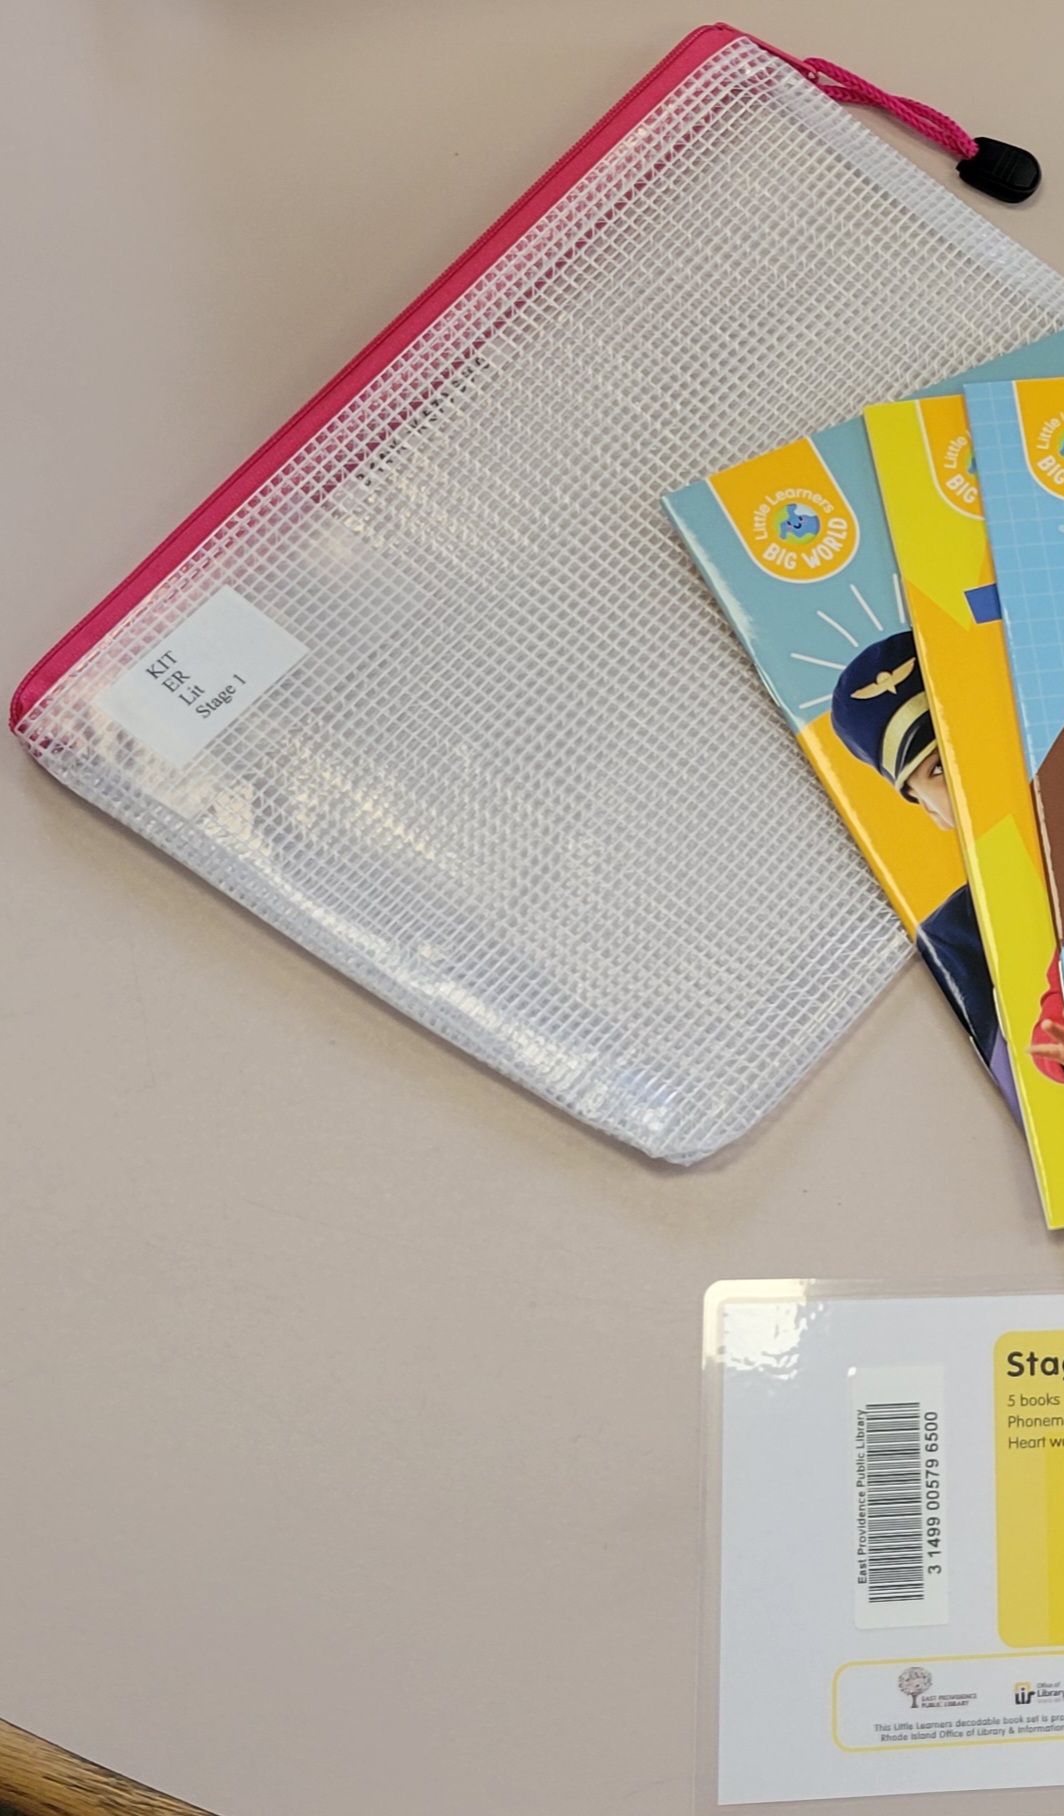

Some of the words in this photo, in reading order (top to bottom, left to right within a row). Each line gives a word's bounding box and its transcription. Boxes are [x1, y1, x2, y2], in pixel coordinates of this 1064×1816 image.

[1036, 417, 1060, 450] Little
[944, 435, 967, 469] Little
[945, 474, 979, 504] BIG
[753, 503, 771, 540] Little
[765, 488, 834, 514] Learners
[762, 542, 798, 570] BIG
[801, 517, 848, 569] WORLD
[145, 650, 178, 680] KIT
[161, 670, 191, 693] ER
[178, 683, 205, 706] Lit
[195, 683, 236, 719] Stage
[232, 673, 247, 685] 1
[1007, 1394, 1015, 1407] 5
[1020, 1393, 1061, 1407] books
[855, 1409, 867, 1449] Library
[924, 1411, 939, 1453] 6500
[1008, 1436, 1046, 1449] Heart
[856, 1453, 866, 1488] Public
[926, 1459, 940, 1511] 00579
[857, 1490, 867, 1555] Providence
[927, 1517, 942, 1558] 1499
[857, 1558, 867, 1584] East
[927, 1564, 942, 1574] 3
[874, 1723, 891, 1732] This
[893, 1722, 913, 1731] Little
[916, 1720, 952, 1730] Learners
[955, 1717, 1000, 1728] decodable
[1002, 1715, 1024, 1725] book
[1026, 1714, 1039, 1723] set
[1042, 1714, 1049, 1722] is
[881, 1731, 908, 1742] Rhode
[911, 1730, 937, 1740] Island
[939, 1729, 964, 1739] Office
[966, 1728, 975, 1737] of
[977, 1727, 1005, 1737] Library
[1008, 1726, 1015, 1734] &
